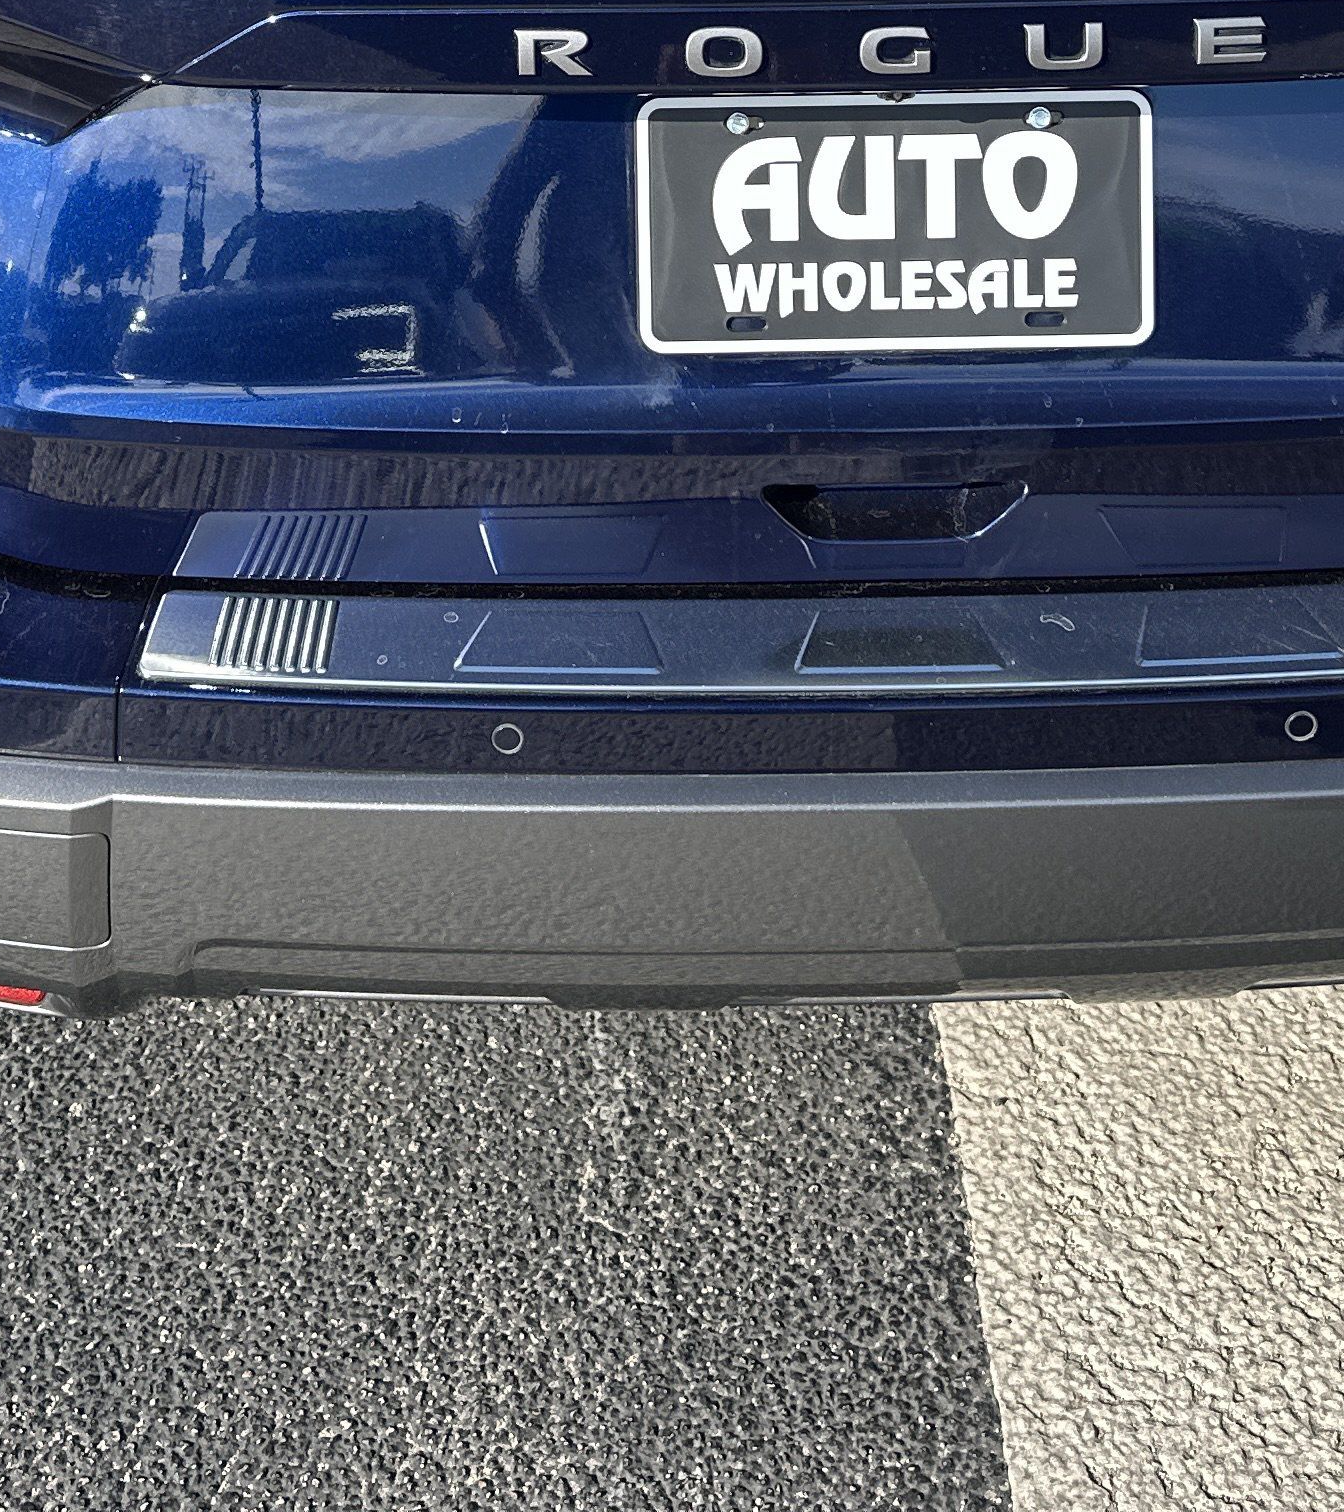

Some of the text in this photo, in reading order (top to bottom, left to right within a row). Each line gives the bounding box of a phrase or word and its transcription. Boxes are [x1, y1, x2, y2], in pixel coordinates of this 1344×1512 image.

[513, 16, 1268, 78] ROGUE
[712, 130, 1078, 256] AUTO
[713, 258, 1079, 318] WHOLESALE
